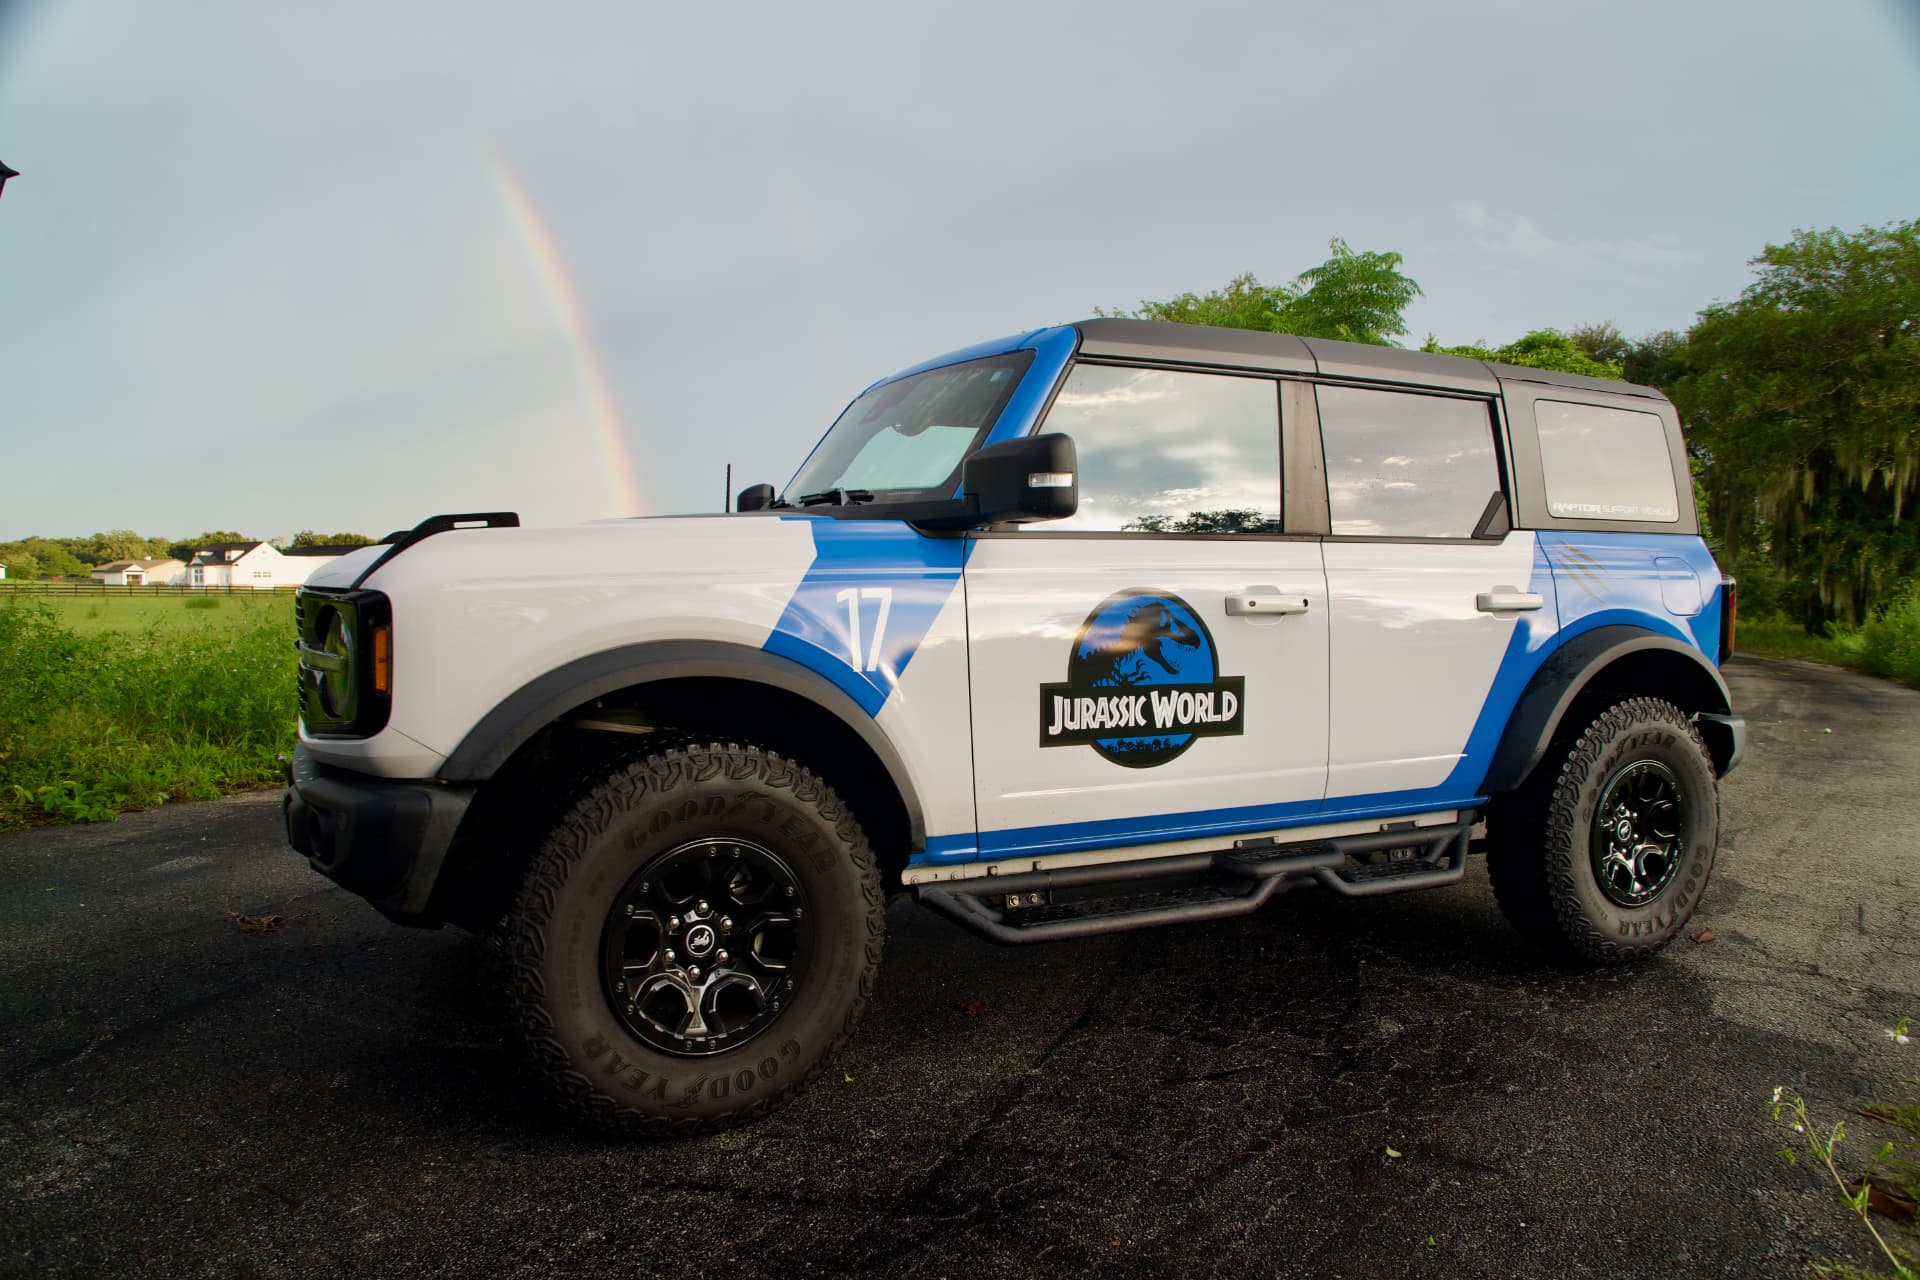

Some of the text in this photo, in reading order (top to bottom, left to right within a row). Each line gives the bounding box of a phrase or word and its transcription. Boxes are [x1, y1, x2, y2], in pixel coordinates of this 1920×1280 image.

[1553, 502, 1600, 514] RAPTOR
[1602, 504, 1639, 513] SUPPORT
[836, 587, 893, 673] 17
[1049, 689, 1238, 736] JURASSIC WORLD
